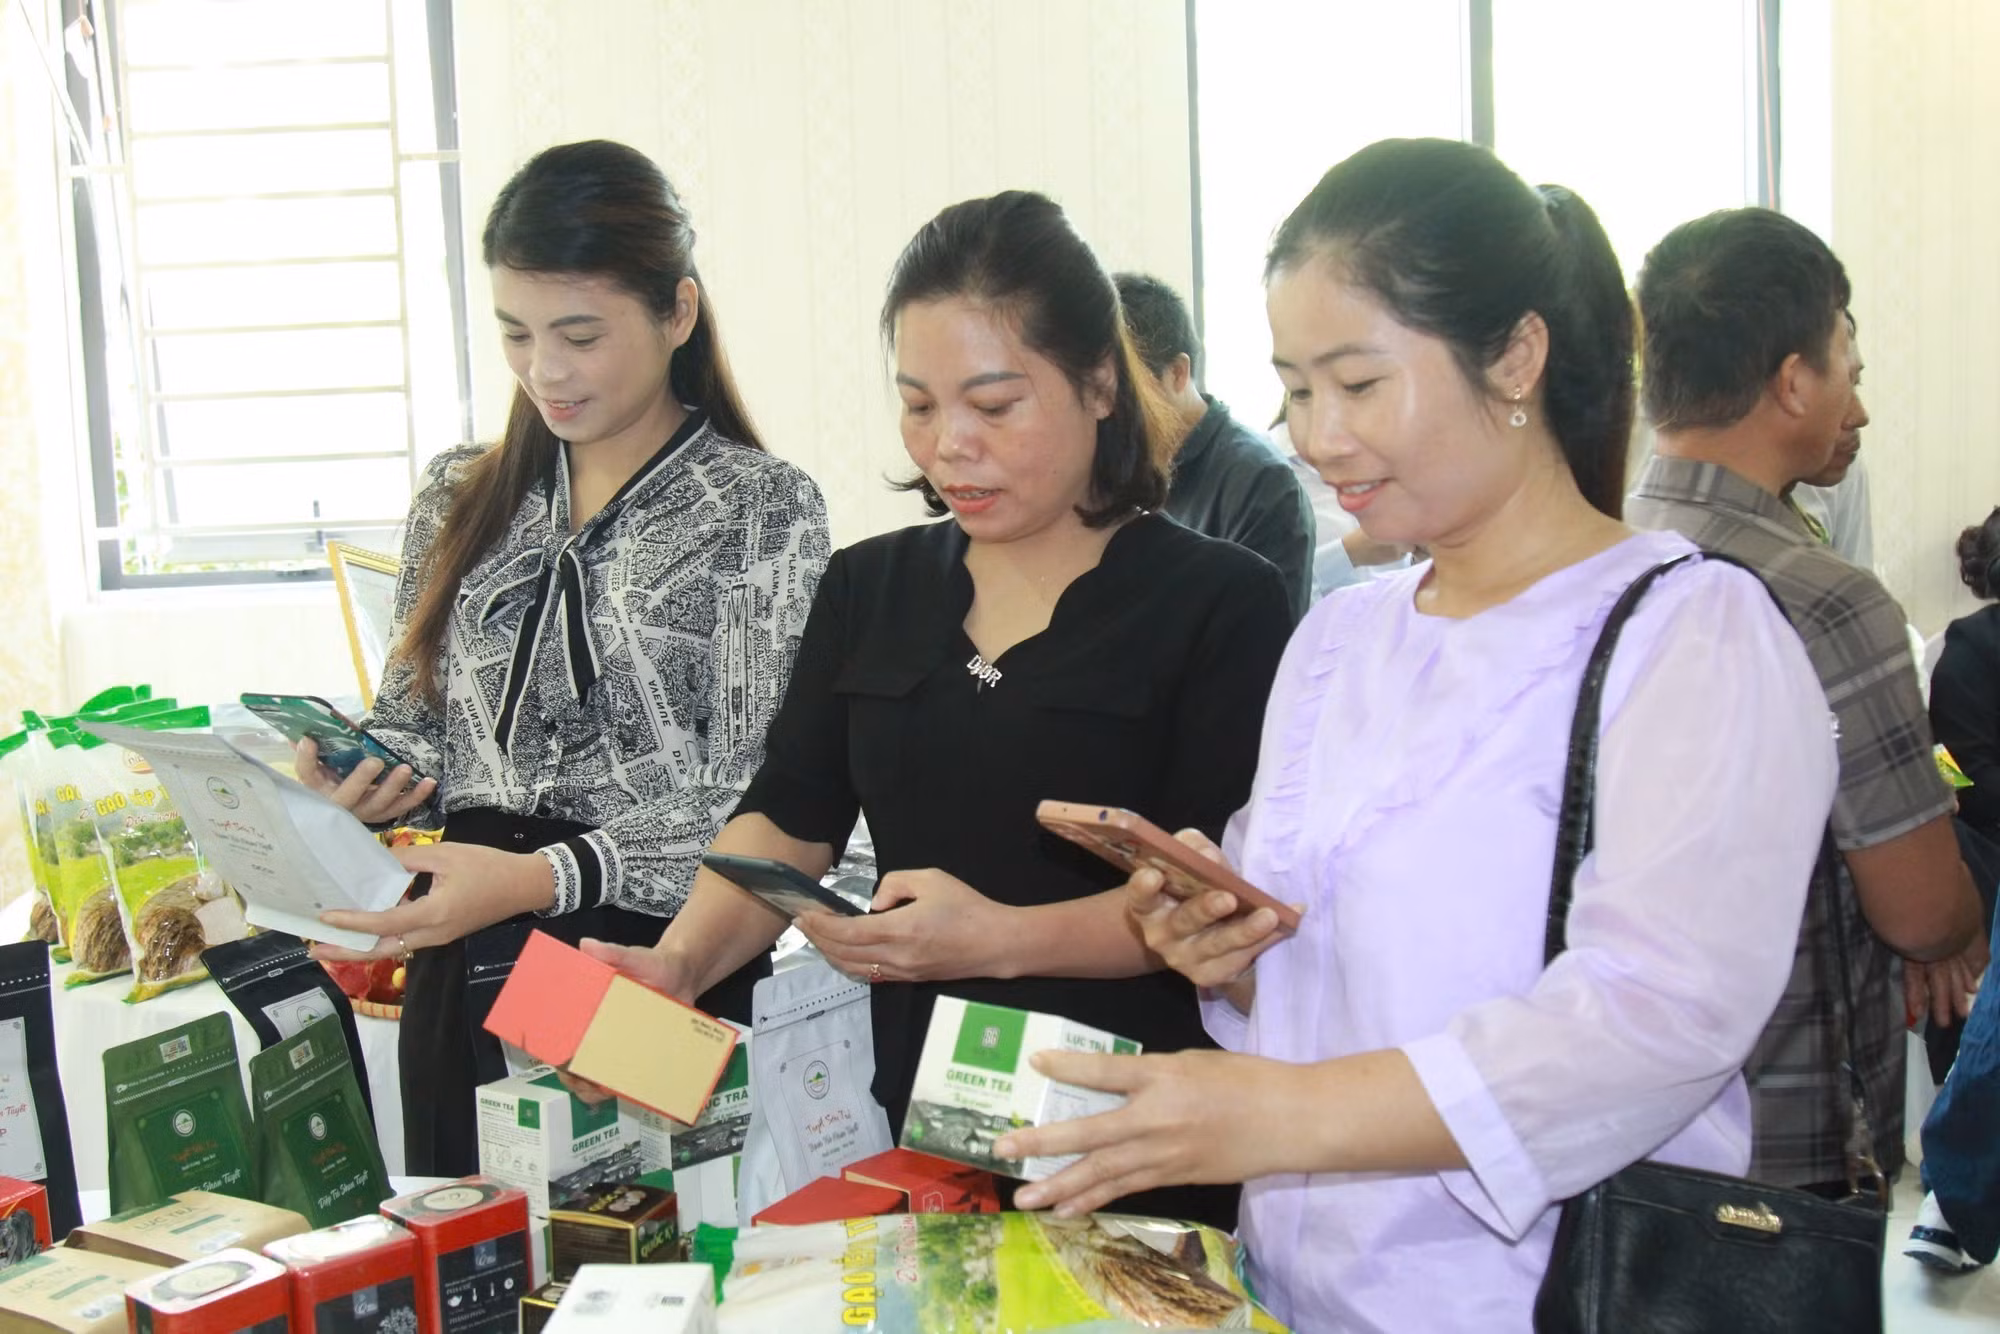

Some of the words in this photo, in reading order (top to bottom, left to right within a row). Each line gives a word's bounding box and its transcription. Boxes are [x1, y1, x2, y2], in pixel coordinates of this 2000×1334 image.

[771, 560, 780, 597] L'ALMA
[788, 552, 797, 585] PLACE
[787, 588, 796, 601] DE
[946, 1069, 988, 1088] GREEN
[991, 1079, 1014, 1092] TEA
[480, 1097, 501, 1108] GREEN
[502, 1102, 515, 1111] TEA
[572, 1133, 601, 1152] GREEN
[603, 1126, 620, 1140] TEA
